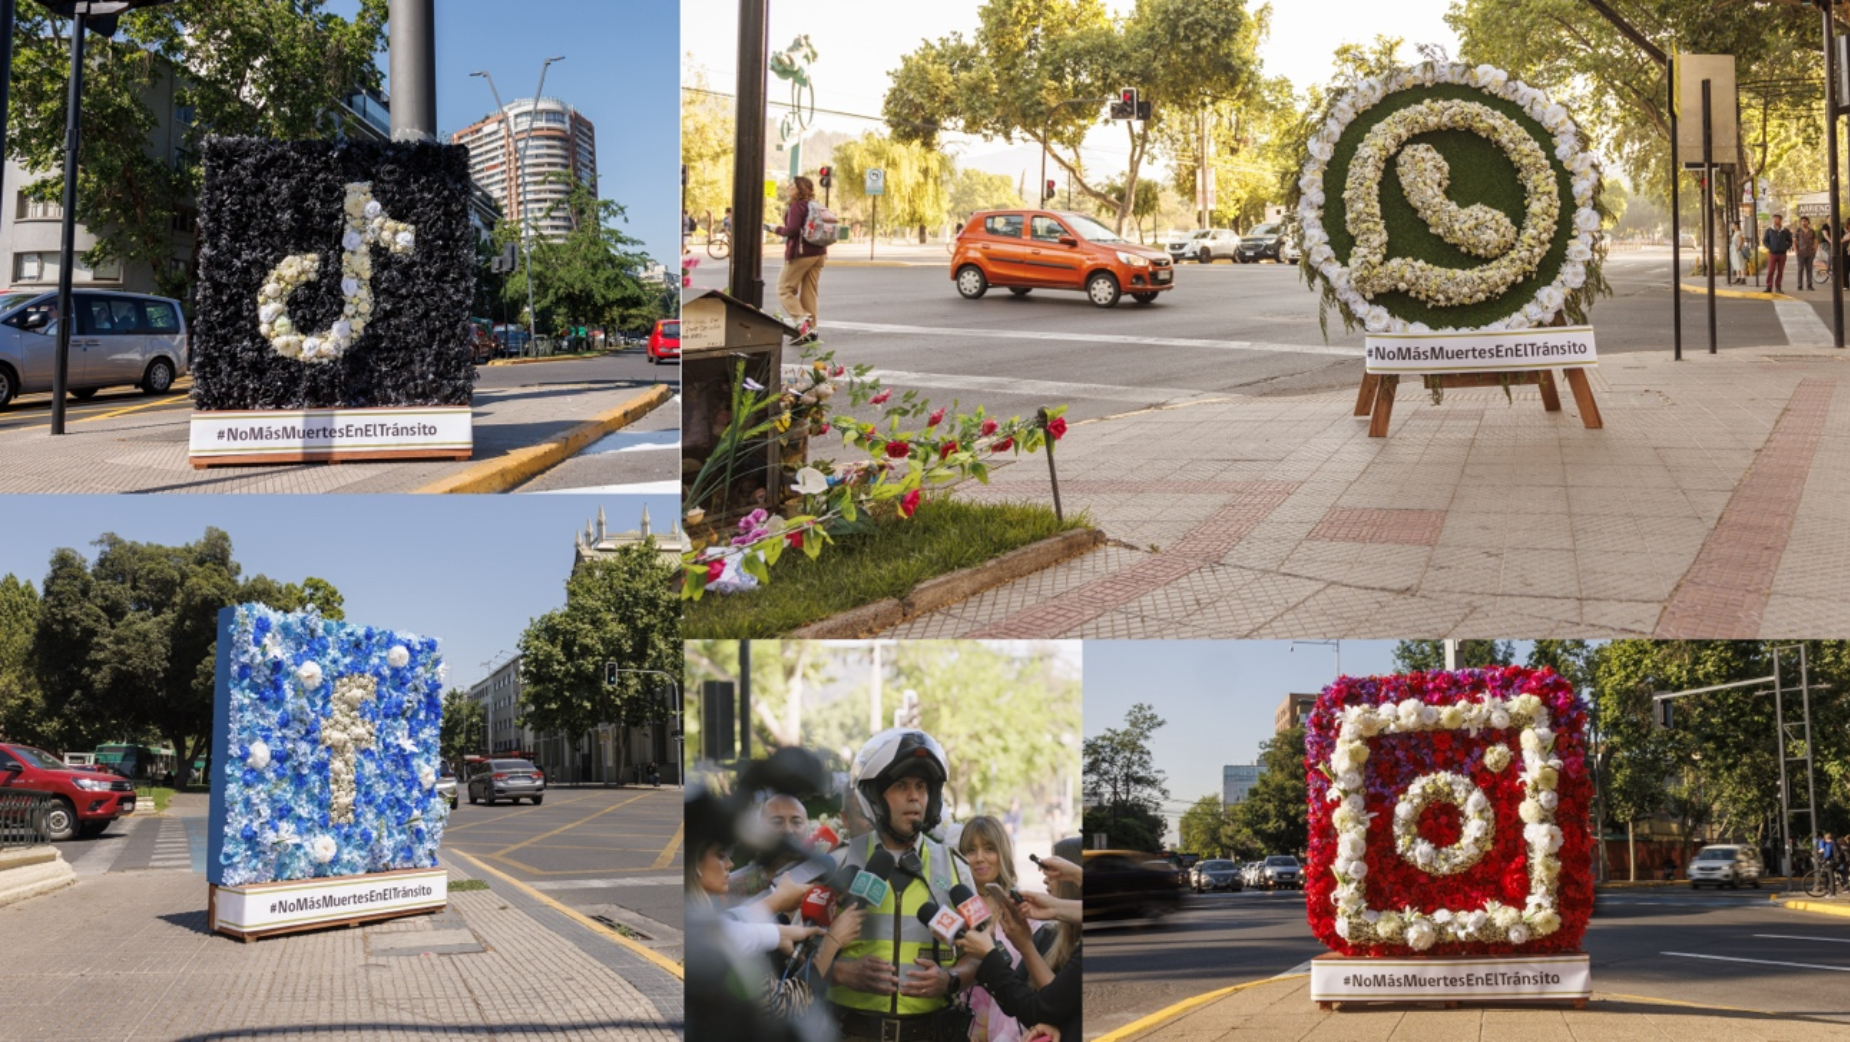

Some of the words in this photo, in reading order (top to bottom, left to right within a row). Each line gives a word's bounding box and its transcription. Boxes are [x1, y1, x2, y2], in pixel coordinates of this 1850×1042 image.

[1367, 340, 1587, 361] #NoMásMuertesEnElTránsito
[216, 422, 438, 442] #NoMásMuertesEnElTránsito
[270, 884, 432, 914] #NoMásMuertesEnElTránsito
[936, 912, 957, 931] 13
[1343, 971, 1561, 988] #NoMásMuertesEnElTránsito
